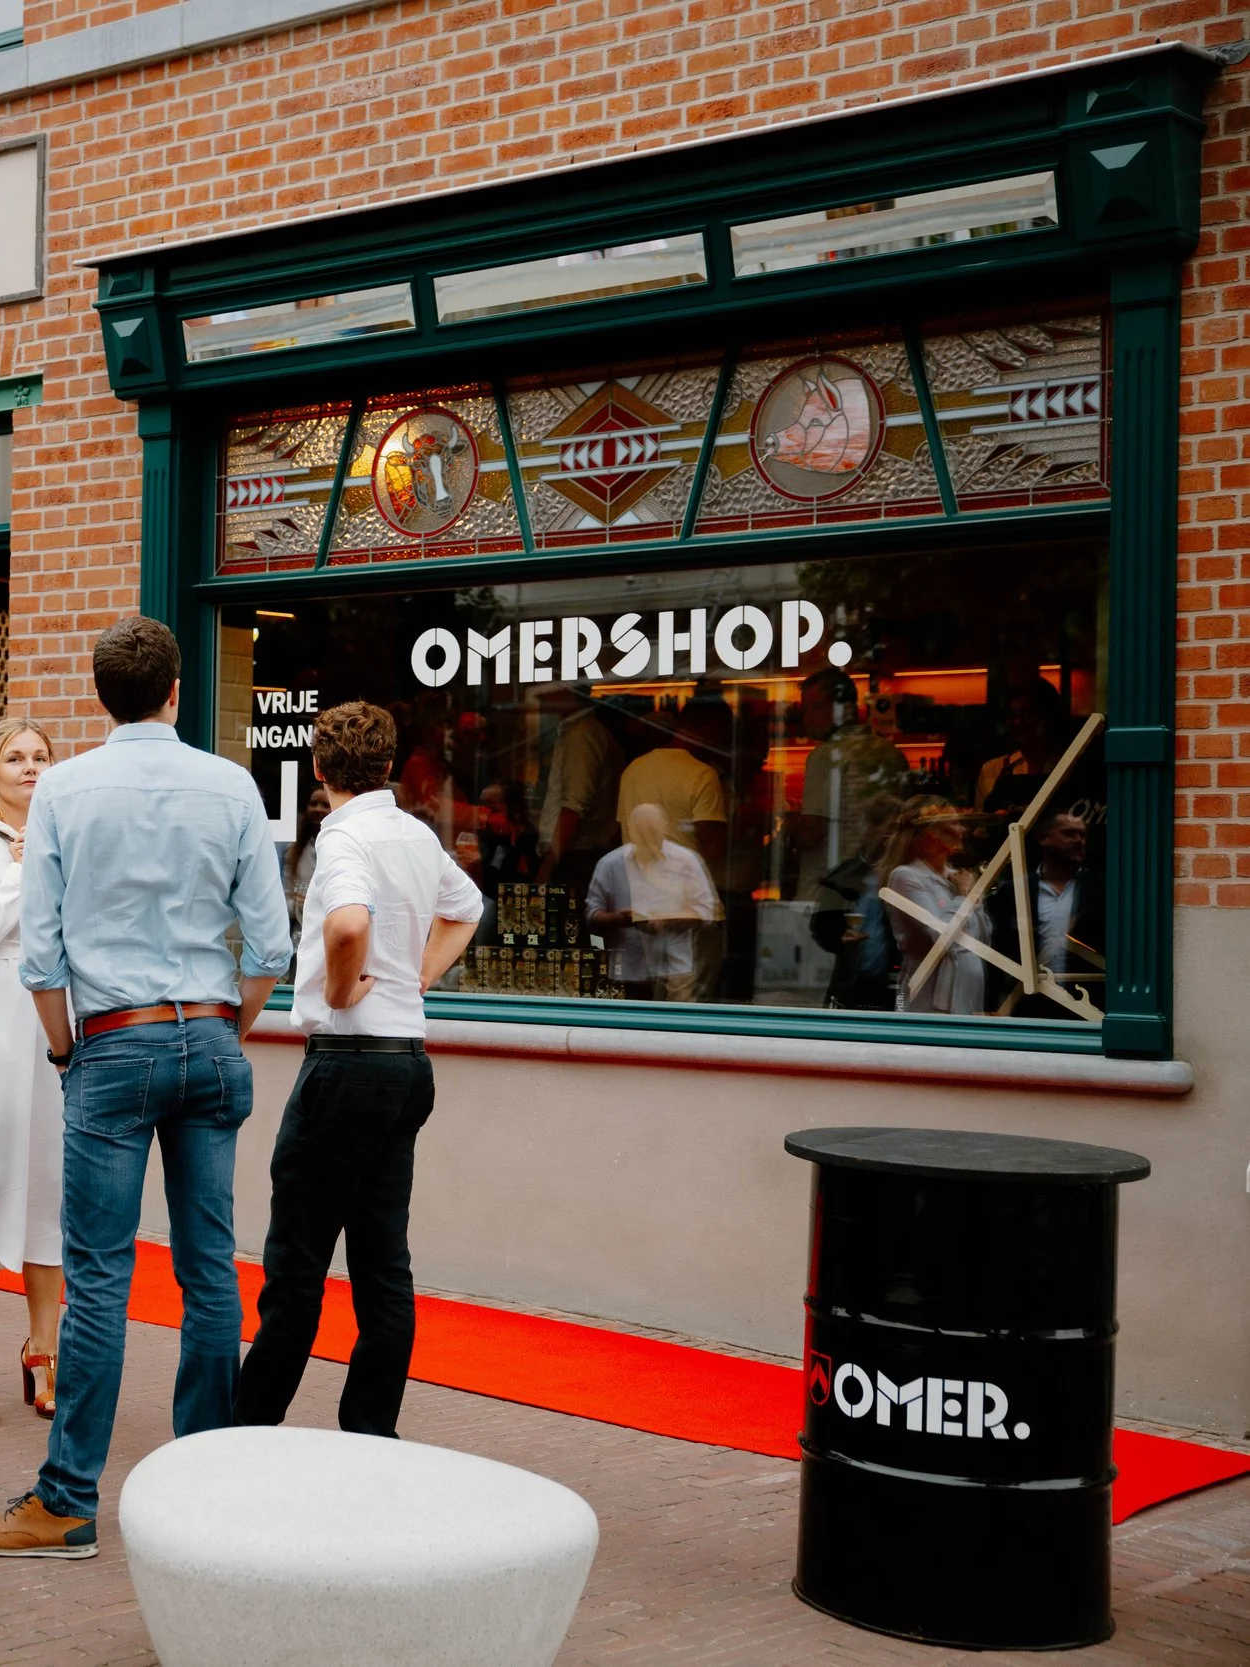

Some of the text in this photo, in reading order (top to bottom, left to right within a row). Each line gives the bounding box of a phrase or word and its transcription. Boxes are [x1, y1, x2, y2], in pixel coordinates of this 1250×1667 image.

[411, 600, 852, 687] OMERSHOP.
[257, 690, 319, 714] VRIJE
[246, 725, 315, 749] INGAN
[834, 1362, 1031, 1440] OMER.
